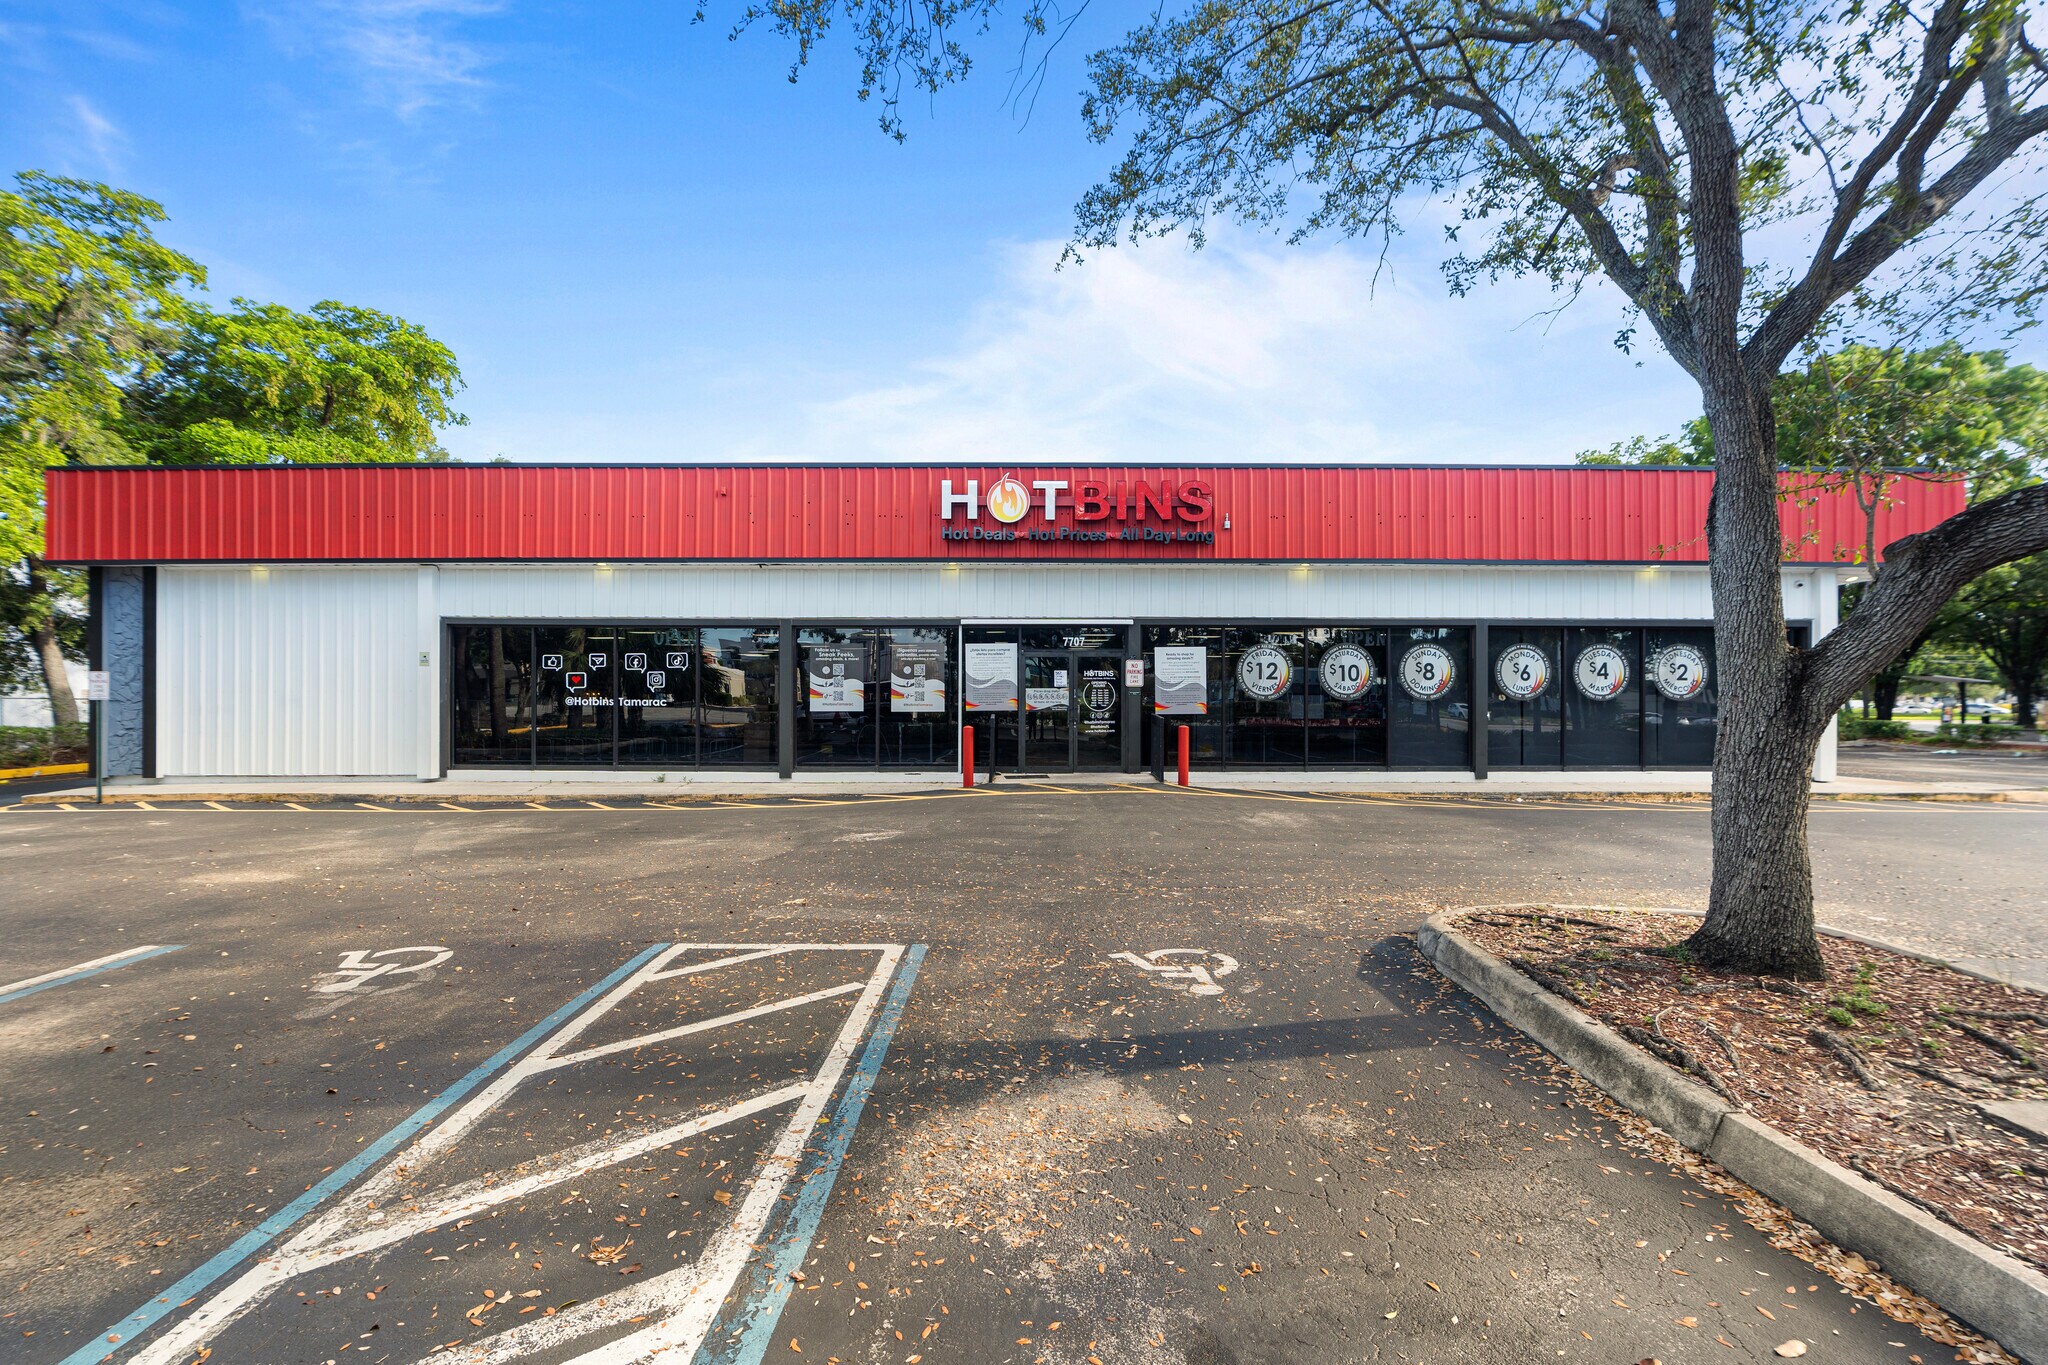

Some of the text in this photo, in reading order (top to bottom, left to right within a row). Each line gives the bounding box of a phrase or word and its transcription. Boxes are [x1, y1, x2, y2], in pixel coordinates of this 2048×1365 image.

[942, 526, 1214, 544] Hot Deals Hot Prices All Day Long
[1063, 636, 1085, 646] 7707
[1251, 650, 1278, 660] FRIDAY
[1331, 650, 1364, 662] SATURDAY
[1412, 650, 1442, 661] SUNDAY
[1508, 651, 1540, 663] MONDAY
[1583, 650, 1617, 662] TUESDAY
[1662, 651, 1700, 667] WEDNESDAY
[1246, 662, 1278, 680] $12
[1330, 664, 1360, 682] $10
[1416, 662, 1435, 680] $8
[1512, 662, 1531, 681] $6
[1590, 662, 1609, 680] $4
[1670, 662, 1688, 680] $2
[1410, 678, 1444, 692] DOMINGO
[1512, 684, 1533, 692] LUNES
[1588, 682, 1616, 692] MARTES
[565, 697, 667, 706] @Hotbins Tamarac
